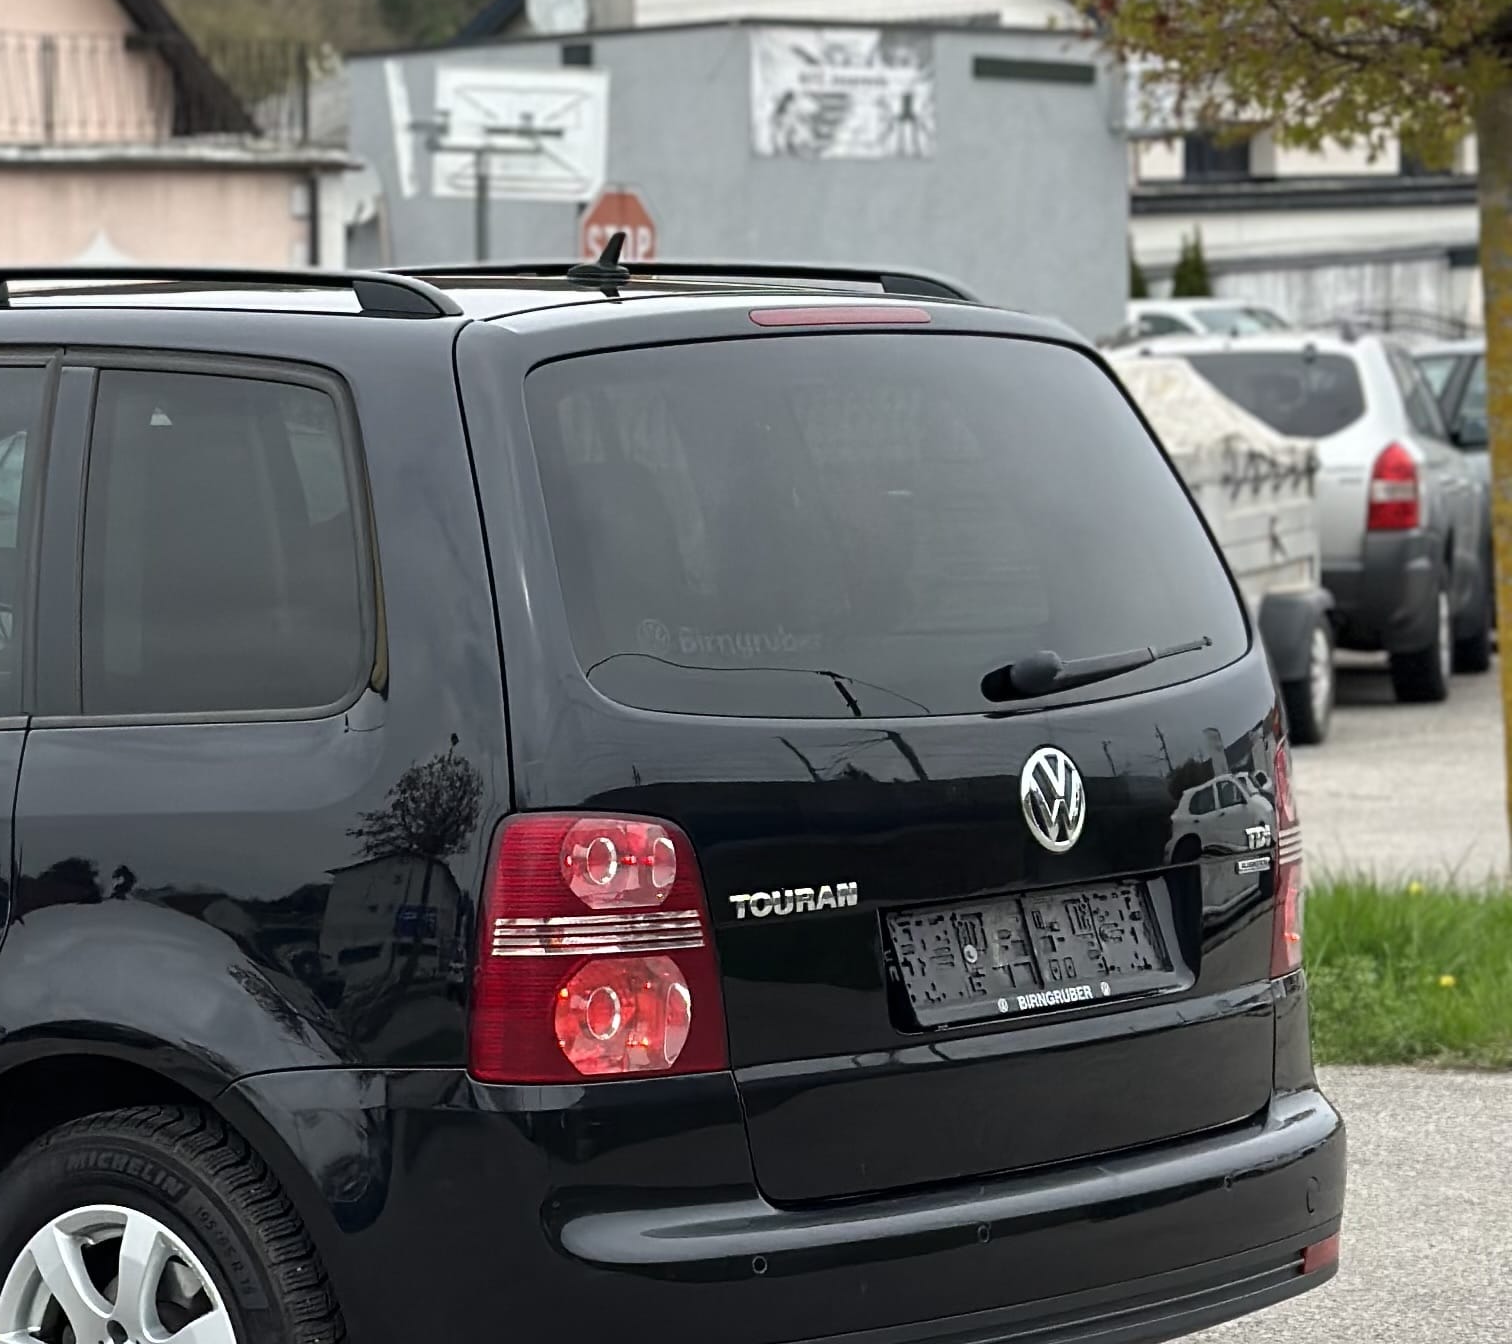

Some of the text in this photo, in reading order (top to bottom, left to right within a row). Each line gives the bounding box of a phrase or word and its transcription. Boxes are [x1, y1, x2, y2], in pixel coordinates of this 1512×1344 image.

[729, 881, 858, 919] TOURAN
[1016, 985, 1094, 1011] BIRNGRUBER
[66, 1151, 186, 1199] MICHELIN
